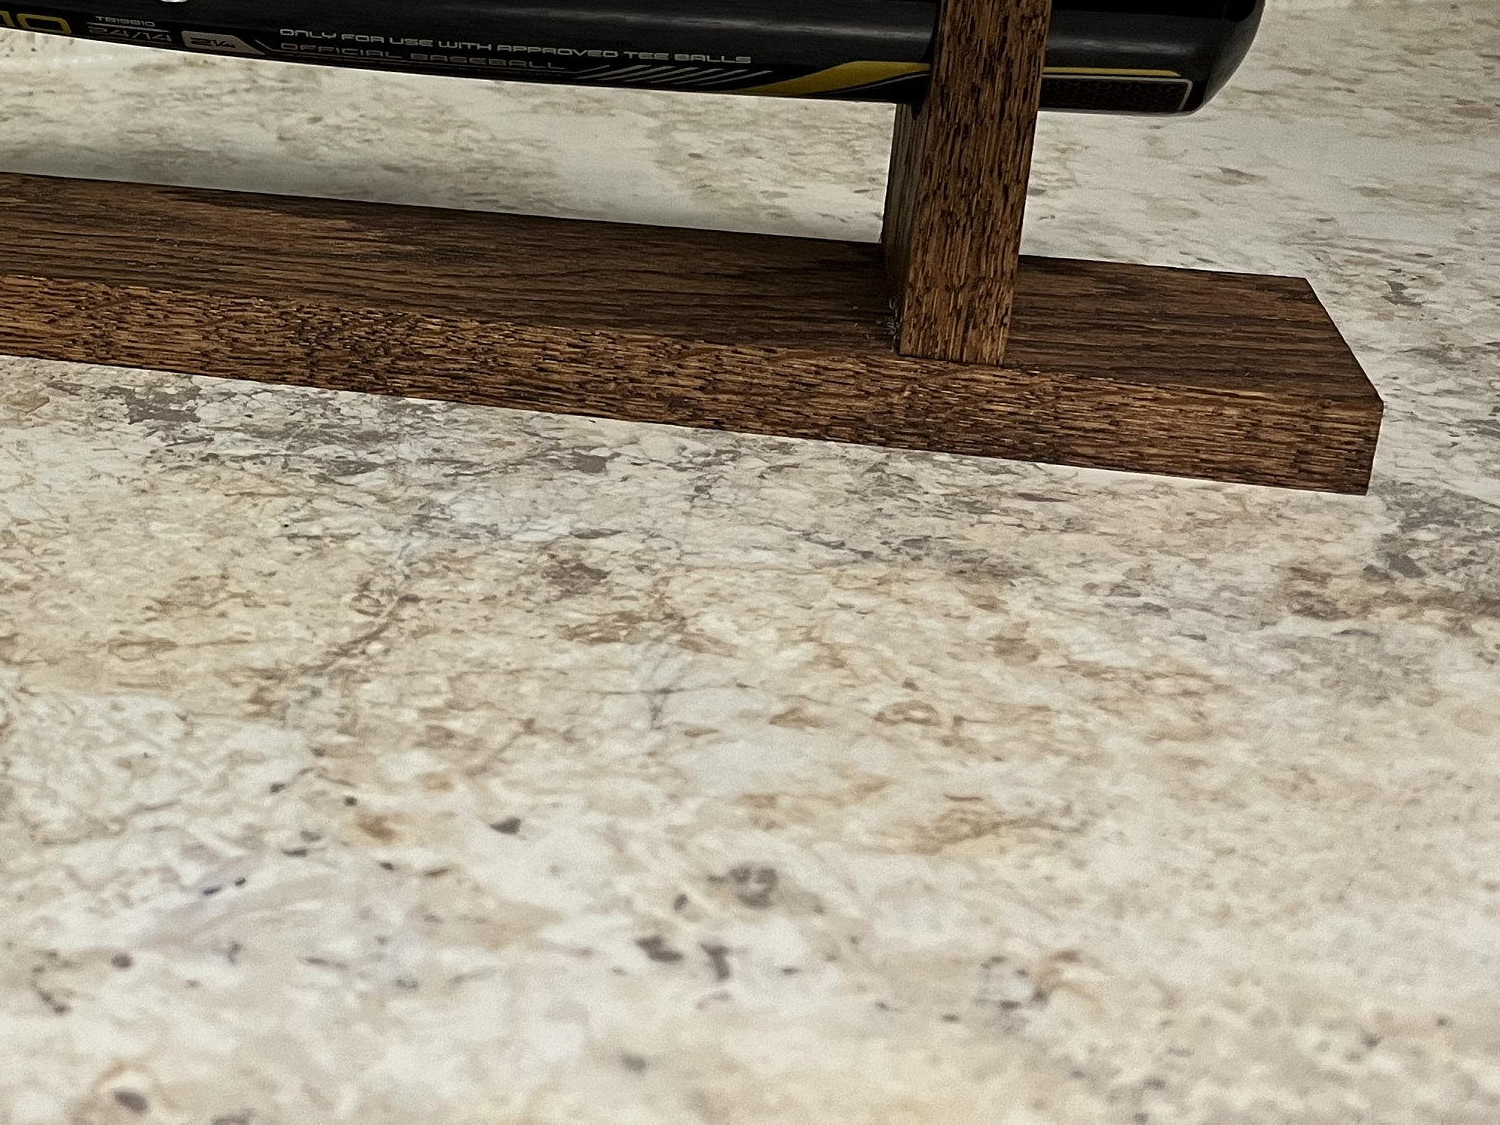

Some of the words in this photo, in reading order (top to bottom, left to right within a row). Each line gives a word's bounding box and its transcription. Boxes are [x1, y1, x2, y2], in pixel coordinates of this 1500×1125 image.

[280, 28, 337, 39] ONLY
[341, 33, 385, 44] FOR
[389, 36, 434, 48] USE
[438, 40, 492, 51] WITH
[497, 44, 619, 59] APPROVED
[623, 50, 670, 61] TEE
[674, 53, 752, 64] BALLS
[280, 42, 403, 58] OFFICIAL
[410, 53, 566, 69] BASEBALL
